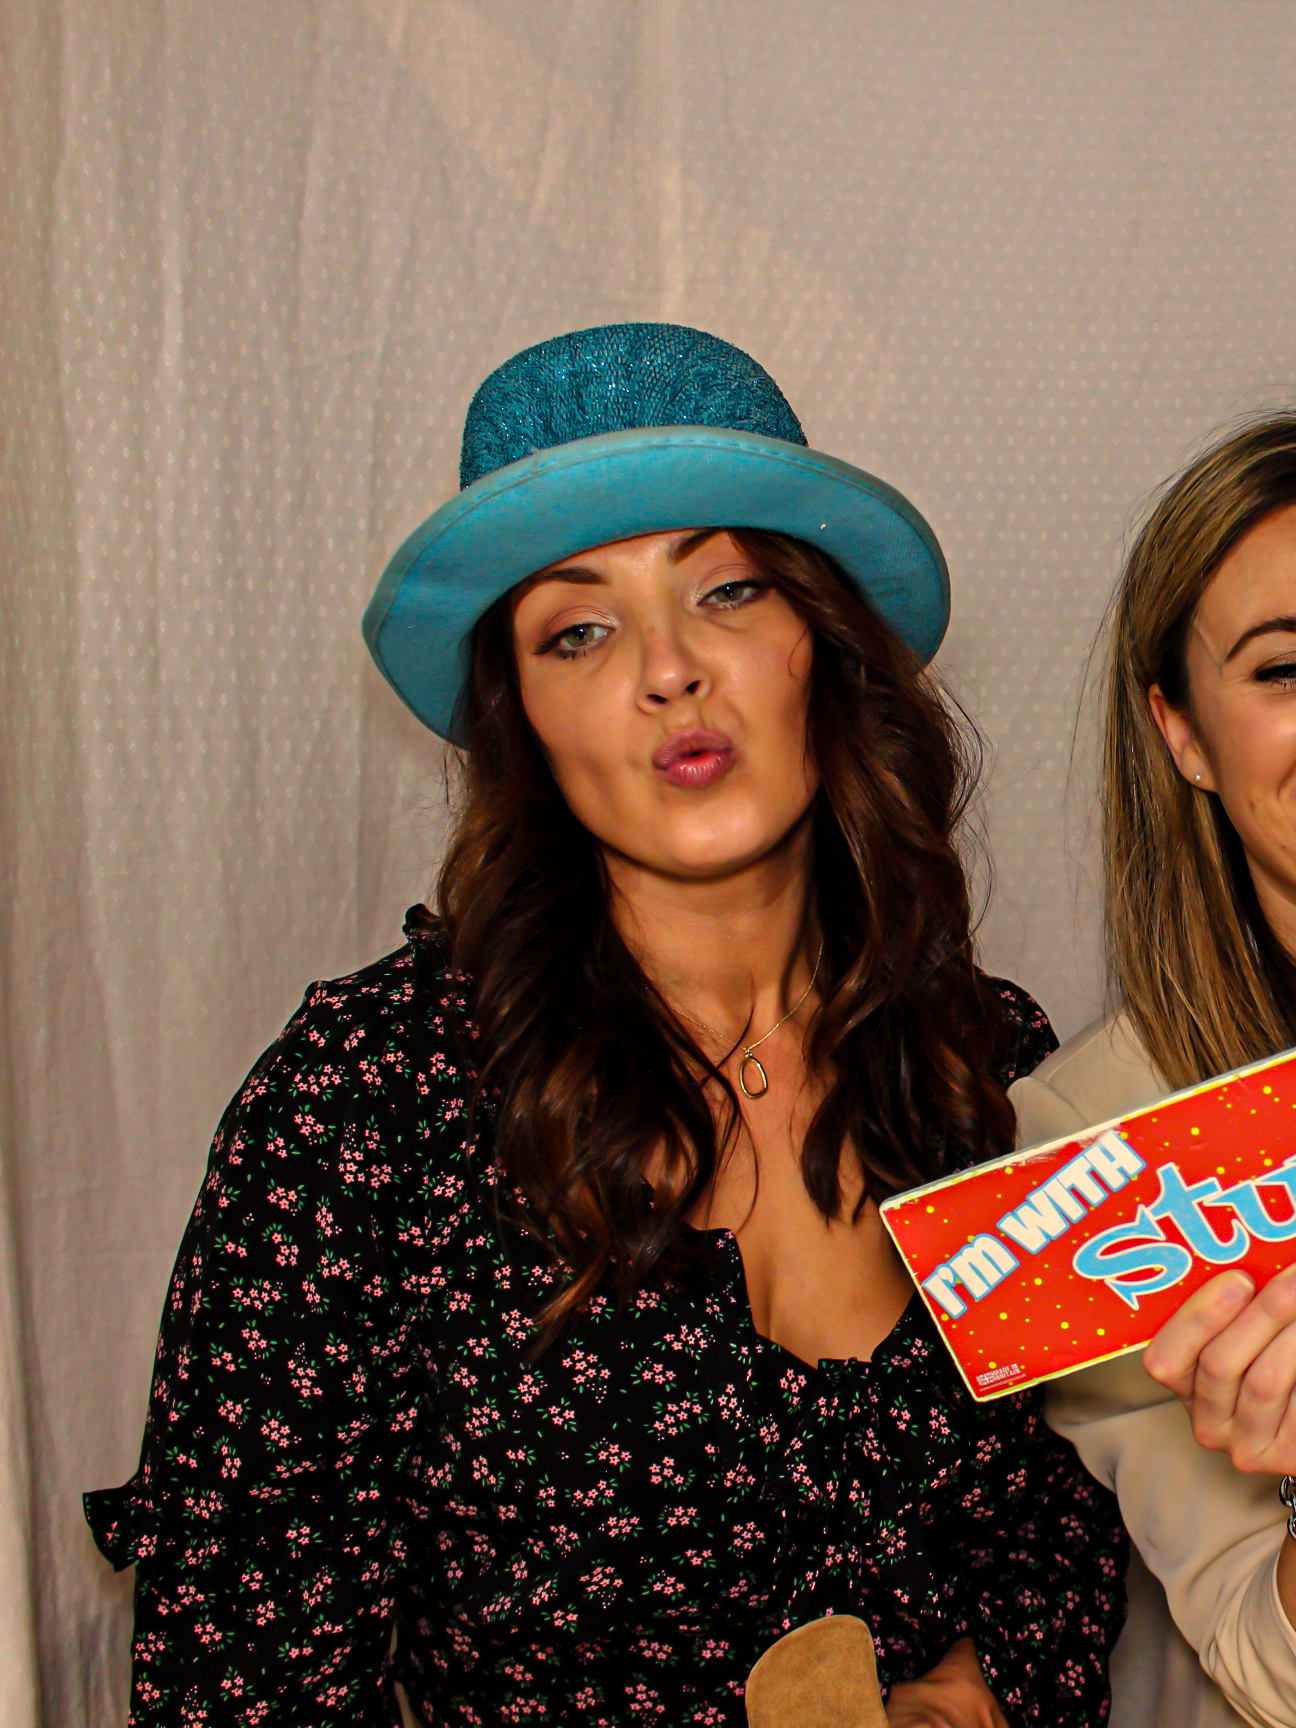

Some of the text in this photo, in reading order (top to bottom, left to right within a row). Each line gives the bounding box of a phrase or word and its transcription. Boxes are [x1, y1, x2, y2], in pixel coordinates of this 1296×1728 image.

[996, 1129, 1147, 1255] WITH
[994, 1366, 1010, 1375] MADE
[995, 1368, 1021, 1380] BRITAIN
